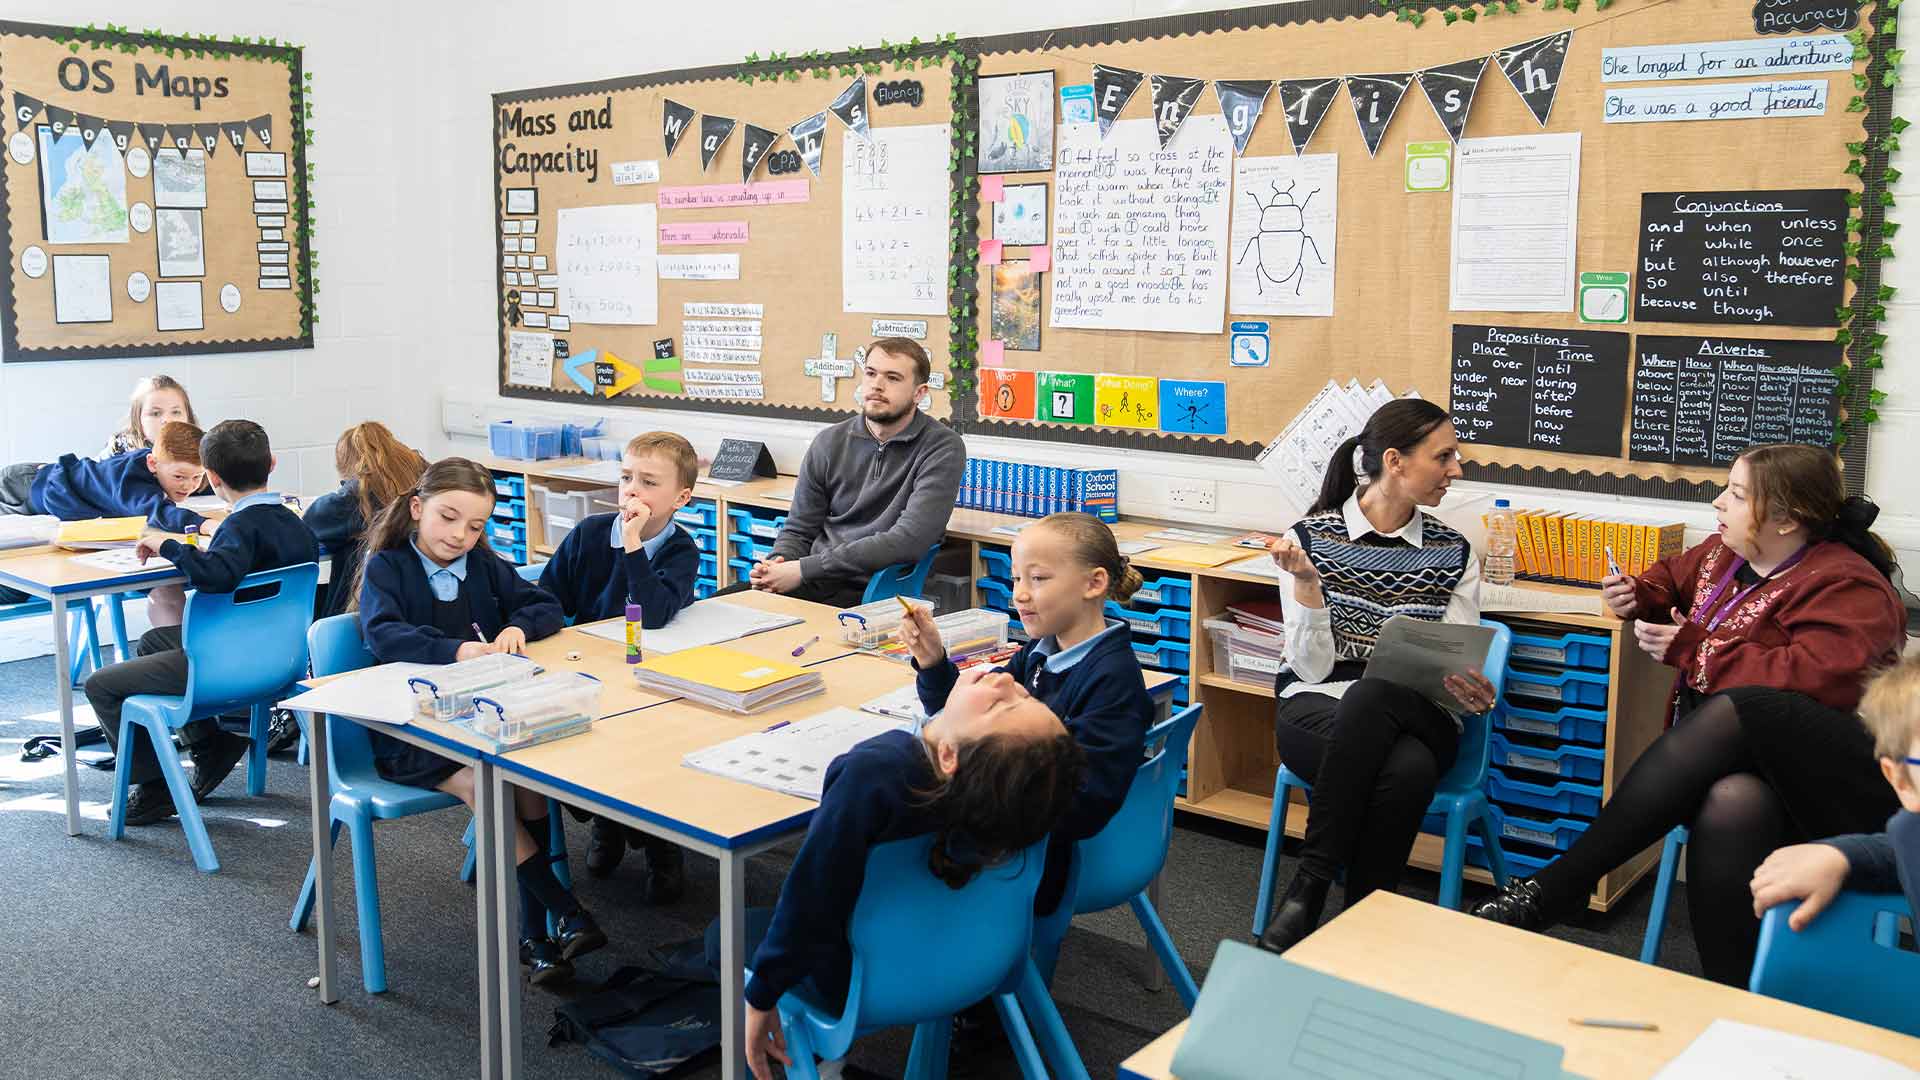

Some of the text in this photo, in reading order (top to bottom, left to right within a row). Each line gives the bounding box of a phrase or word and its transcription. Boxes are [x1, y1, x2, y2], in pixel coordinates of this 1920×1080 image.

[1763, 7, 1848, 30] Accuracy
[1790, 40, 1797, 48] a
[1603, 56, 1629, 76] She
[1637, 55, 1687, 78] longed
[1698, 51, 1725, 74] for
[1735, 58, 1758, 69] an
[57, 56, 230, 111] OS Maps
[879, 88, 920, 105] Fluency
[1605, 96, 1636, 118] She
[1644, 102, 1677, 115] was
[1686, 103, 1697, 113] a
[1710, 92, 1752, 118] good
[502, 97, 612, 139] Mass and
[18, 106, 271, 151] Geography
[1128, 146, 1224, 161] so cross the
[501, 143, 598, 186] Capacity
[769, 154, 797, 172] CPA
[1124, 168, 1147, 176] was
[1202, 160, 1221, 173] the
[1059, 179, 1088, 195] object
[1172, 178, 1189, 189] the
[1199, 177, 1225, 191] spider
[1113, 192, 1154, 204] without
[1675, 195, 1784, 217] Conjunctions
[1127, 211, 1166, 223] amazing
[1176, 204, 1200, 224] thing
[1058, 220, 1208, 233] and wish could hover
[1648, 218, 1837, 233] and when unless
[1057, 234, 1167, 247] over for little
[1650, 236, 1824, 252] if while once
[1128, 250, 1157, 263] spider
[1168, 249, 1185, 261] has
[1644, 252, 1839, 273] but although however
[1103, 263, 1211, 276] around am
[1703, 272, 1738, 283] also
[1764, 271, 1833, 285] therefore
[1057, 275, 1208, 295] not good has
[1704, 286, 1748, 297] until
[1056, 290, 1082, 307] really
[1143, 293, 1160, 304] due
[1168, 291, 1180, 303] to
[1189, 292, 1202, 304] his
[1641, 294, 1696, 310] because
[1714, 301, 1773, 321] though
[877, 323, 919, 334] Subtraction
[1487, 328, 1569, 346] Prepositions
[1472, 343, 1595, 361] Place Time
[1698, 340, 1766, 357] Adverbs
[813, 361, 845, 371] Addition
[1457, 354, 1570, 375] in over until
[1642, 353, 1677, 367] Where
[1685, 357, 1712, 368] How
[1724, 360, 1754, 371] When
[1759, 364, 1776, 372] How
[1801, 366, 1820, 374] How
[995, 373, 1017, 382] Who?
[1053, 378, 1076, 388] What?
[1454, 372, 1577, 395] under near during
[1638, 369, 1796, 386] above angrily before always
[1174, 387, 1209, 397] Where?
[1452, 384, 1497, 403] through
[1535, 391, 1572, 402] after
[1637, 381, 1672, 391] below
[1760, 383, 1789, 396] daily
[1679, 389, 1713, 401] gently
[1453, 400, 1573, 418] beside before
[1636, 391, 1675, 403] inside
[1680, 401, 1712, 412] loudly
[1721, 392, 1752, 401] never
[1757, 395, 1792, 407] weekly
[1635, 403, 1825, 419] here hourly very
[1473, 417, 1493, 429] top
[1535, 419, 1564, 430] now
[1634, 418, 1671, 431] there
[1718, 414, 1748, 428] today
[1795, 416, 1832, 426] almost
[1717, 422, 1784, 432] after often
[1455, 429, 1561, 445] out next
[1632, 433, 1664, 447] away
[1752, 431, 1789, 440] usually
[1794, 427, 1832, 441] entirely
[1631, 443, 1670, 454] upstairs
[1715, 443, 1744, 451] often
[1085, 472, 1116, 483] Oxford
[1085, 482, 1116, 491] School
[1085, 491, 1116, 499] Dictionary
[1532, 520, 1545, 554] OXFORD
[1549, 521, 1559, 555] OXFORD
